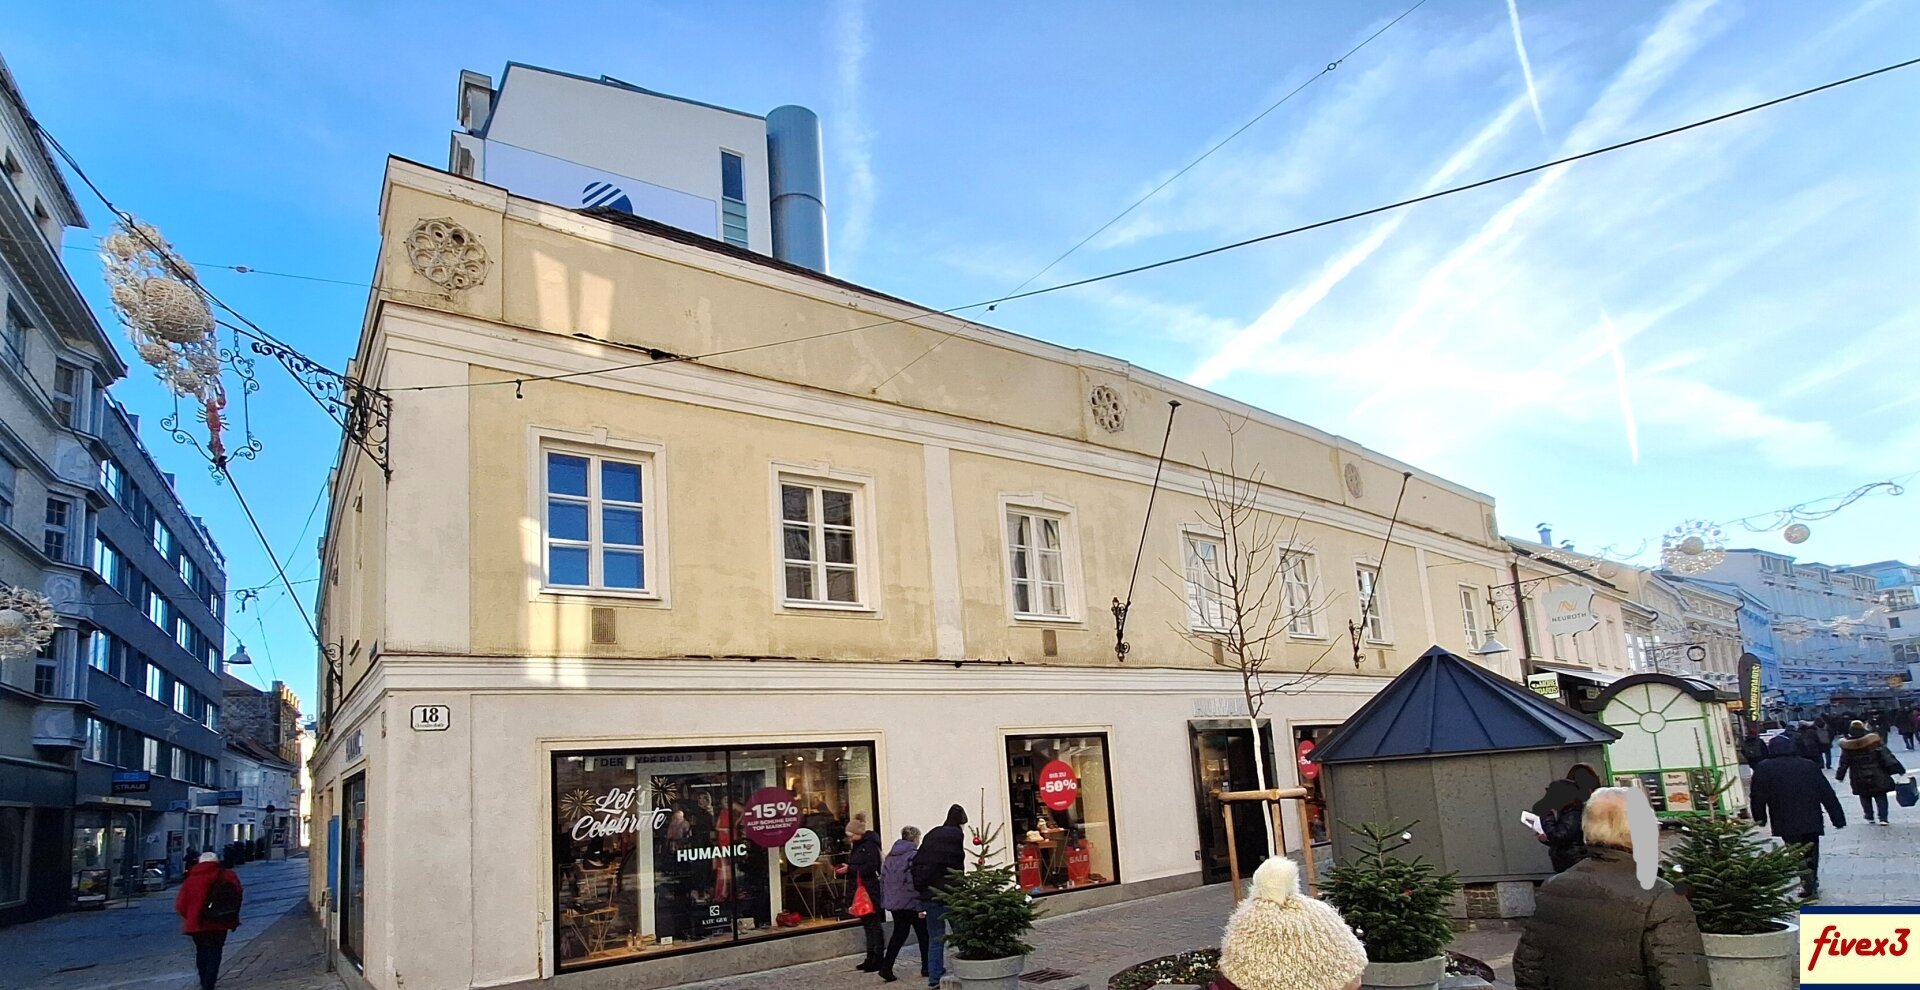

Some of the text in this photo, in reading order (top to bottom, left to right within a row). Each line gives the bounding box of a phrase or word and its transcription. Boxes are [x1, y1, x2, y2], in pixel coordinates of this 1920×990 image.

[1552, 613, 1587, 622] NEUROTH
[421, 707, 439, 723] 18
[600, 757, 624, 767] DER
[1040, 779, 1077, 793] -50%
[595, 784, 646, 814] Let's
[745, 801, 798, 818] -15%
[572, 807, 672, 841] Celebrate
[677, 843, 748, 862] HUMANIC
[1069, 854, 1088, 864] SALE
[1018, 862, 1039, 870] SALE
